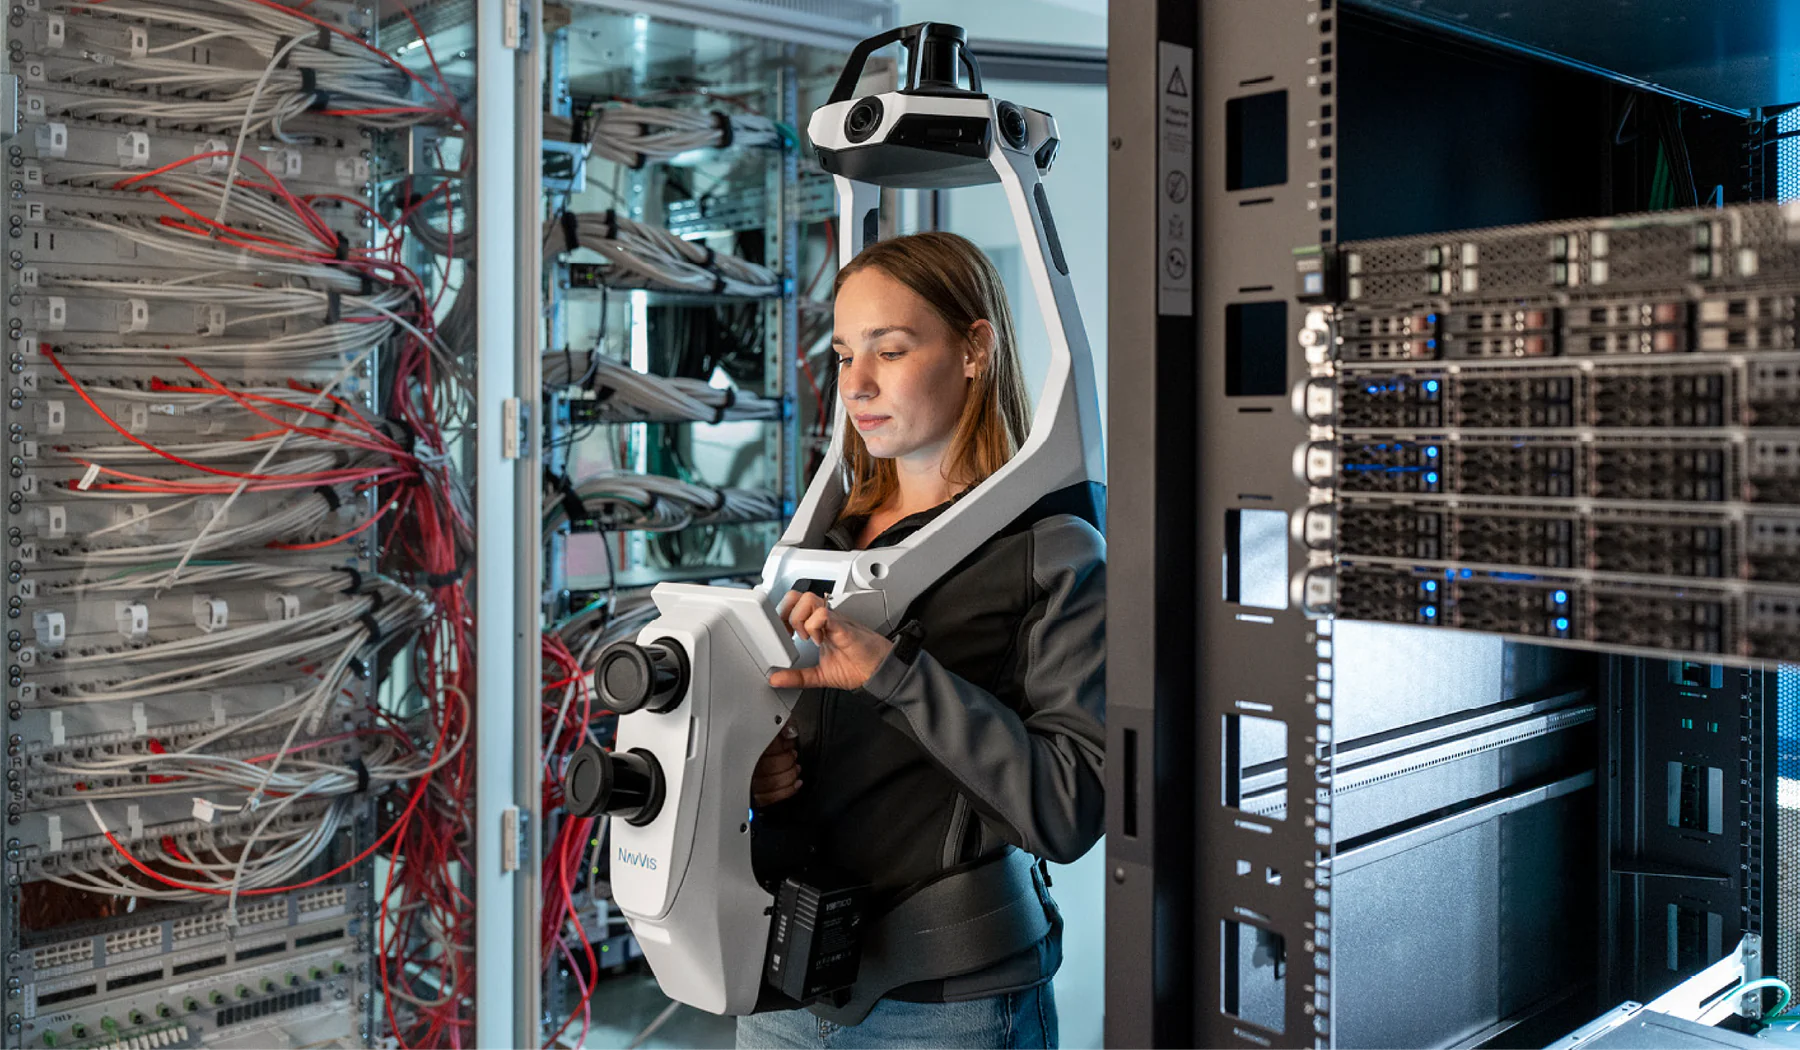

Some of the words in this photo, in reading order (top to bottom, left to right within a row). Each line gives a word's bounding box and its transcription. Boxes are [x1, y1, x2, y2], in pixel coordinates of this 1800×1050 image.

[30, 65, 40, 76] C
[31, 99, 40, 110] D
[28, 171, 37, 180] E
[30, 204, 41, 218] F
[24, 272, 33, 282] H
[23, 376, 32, 386] K
[23, 443, 33, 457] L
[22, 477, 31, 491] J
[21, 547, 32, 558] M
[21, 584, 31, 594] N
[22, 686, 31, 697] P
